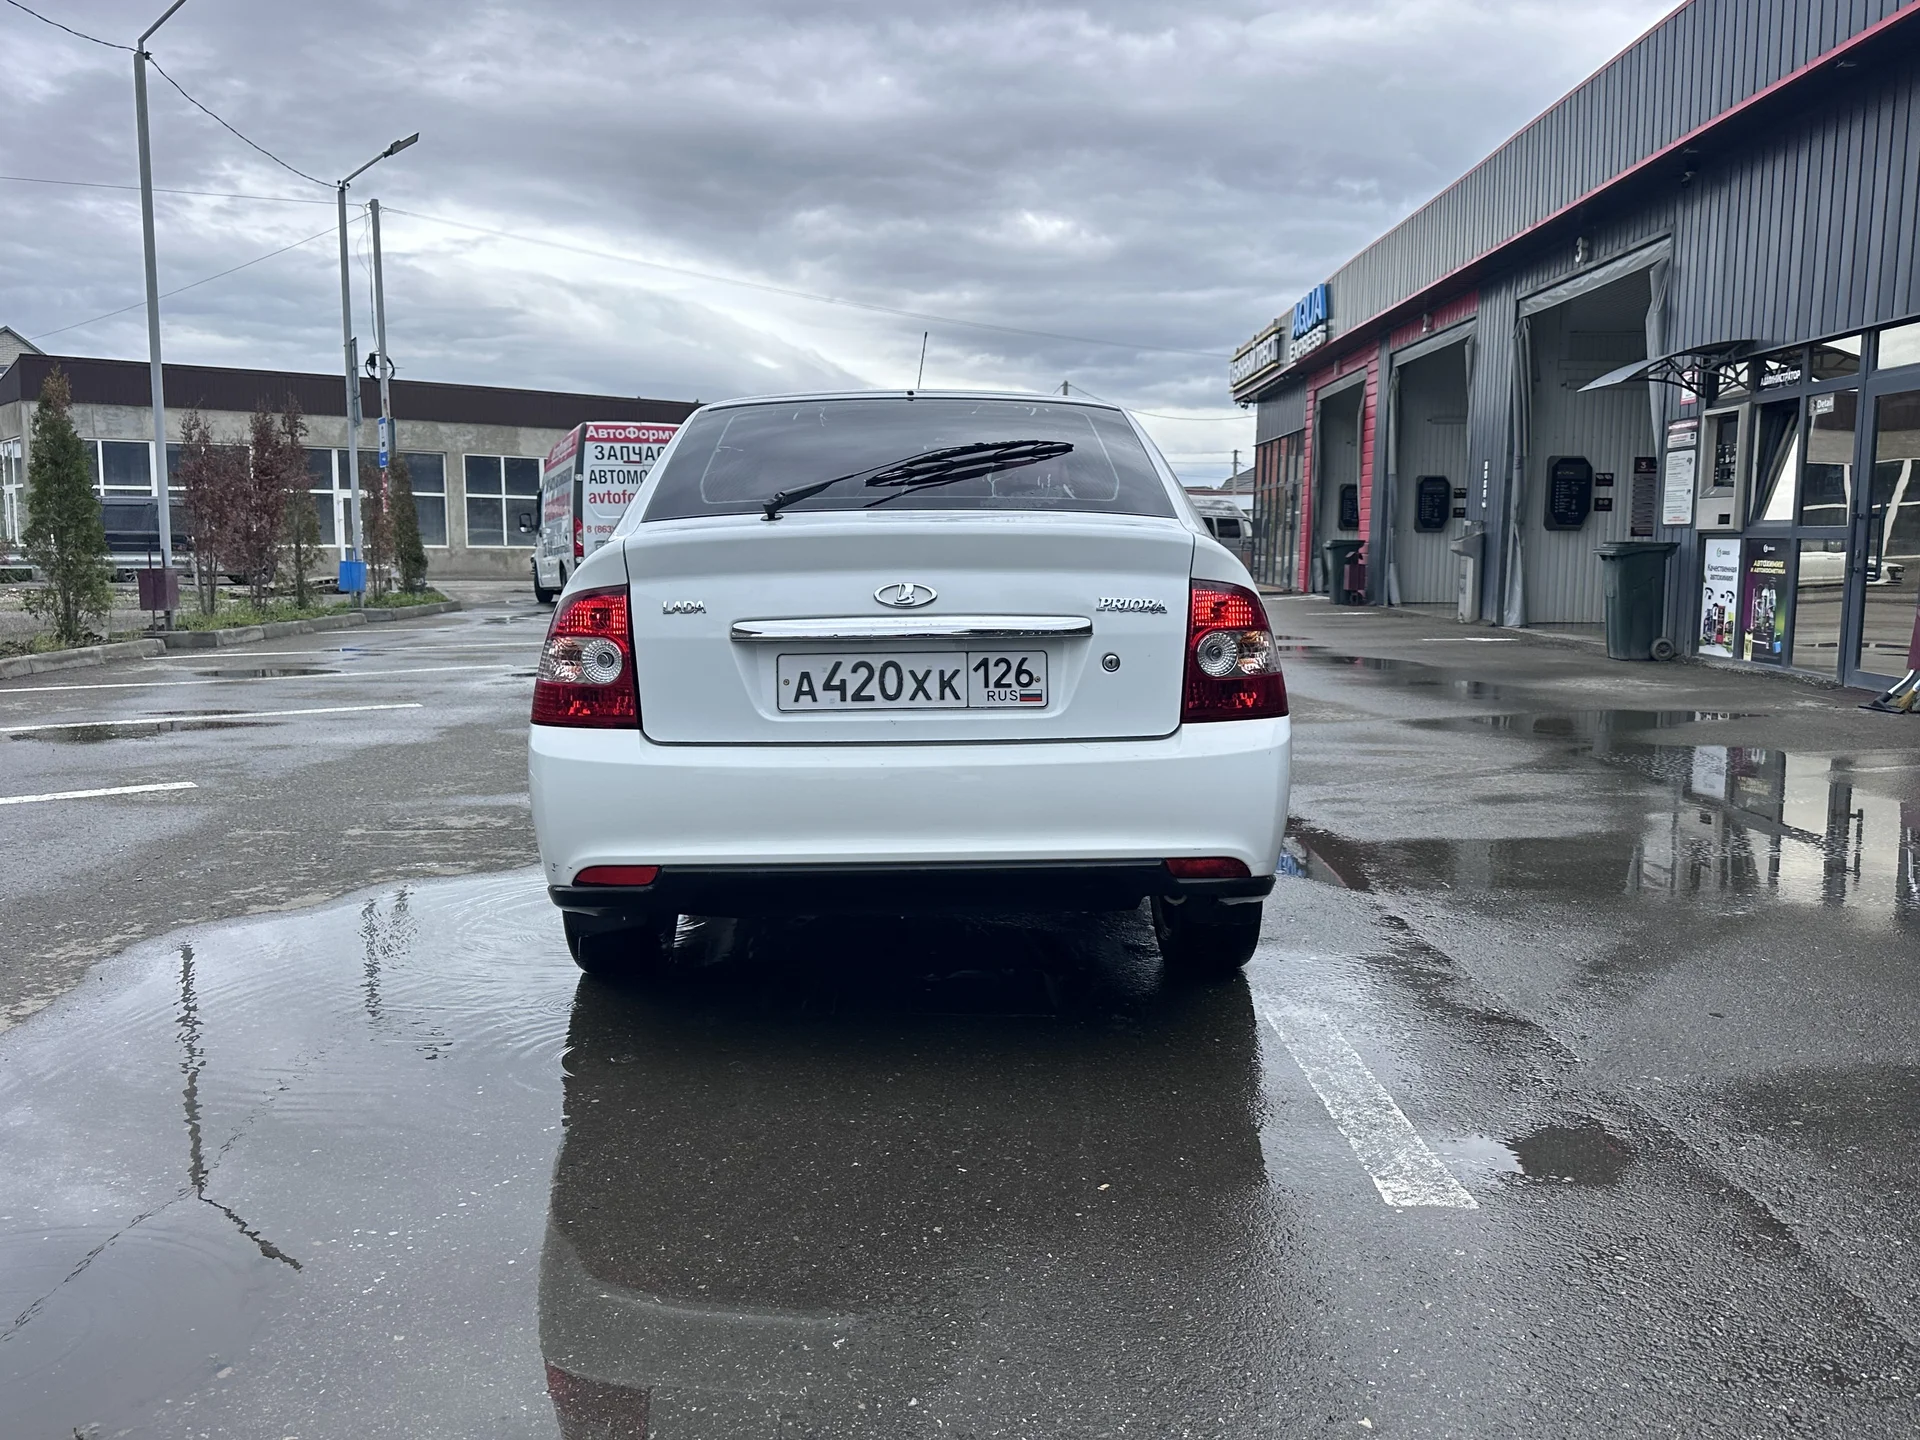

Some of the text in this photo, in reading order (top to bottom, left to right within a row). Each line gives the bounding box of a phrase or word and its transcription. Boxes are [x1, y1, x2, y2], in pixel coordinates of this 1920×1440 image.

[1291, 283, 1327, 341] AQUA
[1289, 324, 1327, 363] EXPRESS
[1760, 369, 1801, 387] АДМИНИСТРАТОР
[586, 525, 592, 533] 8
[1707, 563, 1737, 573] Качественная
[1753, 560, 1784, 569] АВТОХИМИЯ
[663, 600, 707, 614] LADA
[1096, 597, 1168, 614] PRIORA
[793, 657, 1034, 702] А420ХК 126
[986, 689, 1018, 702] RUS
